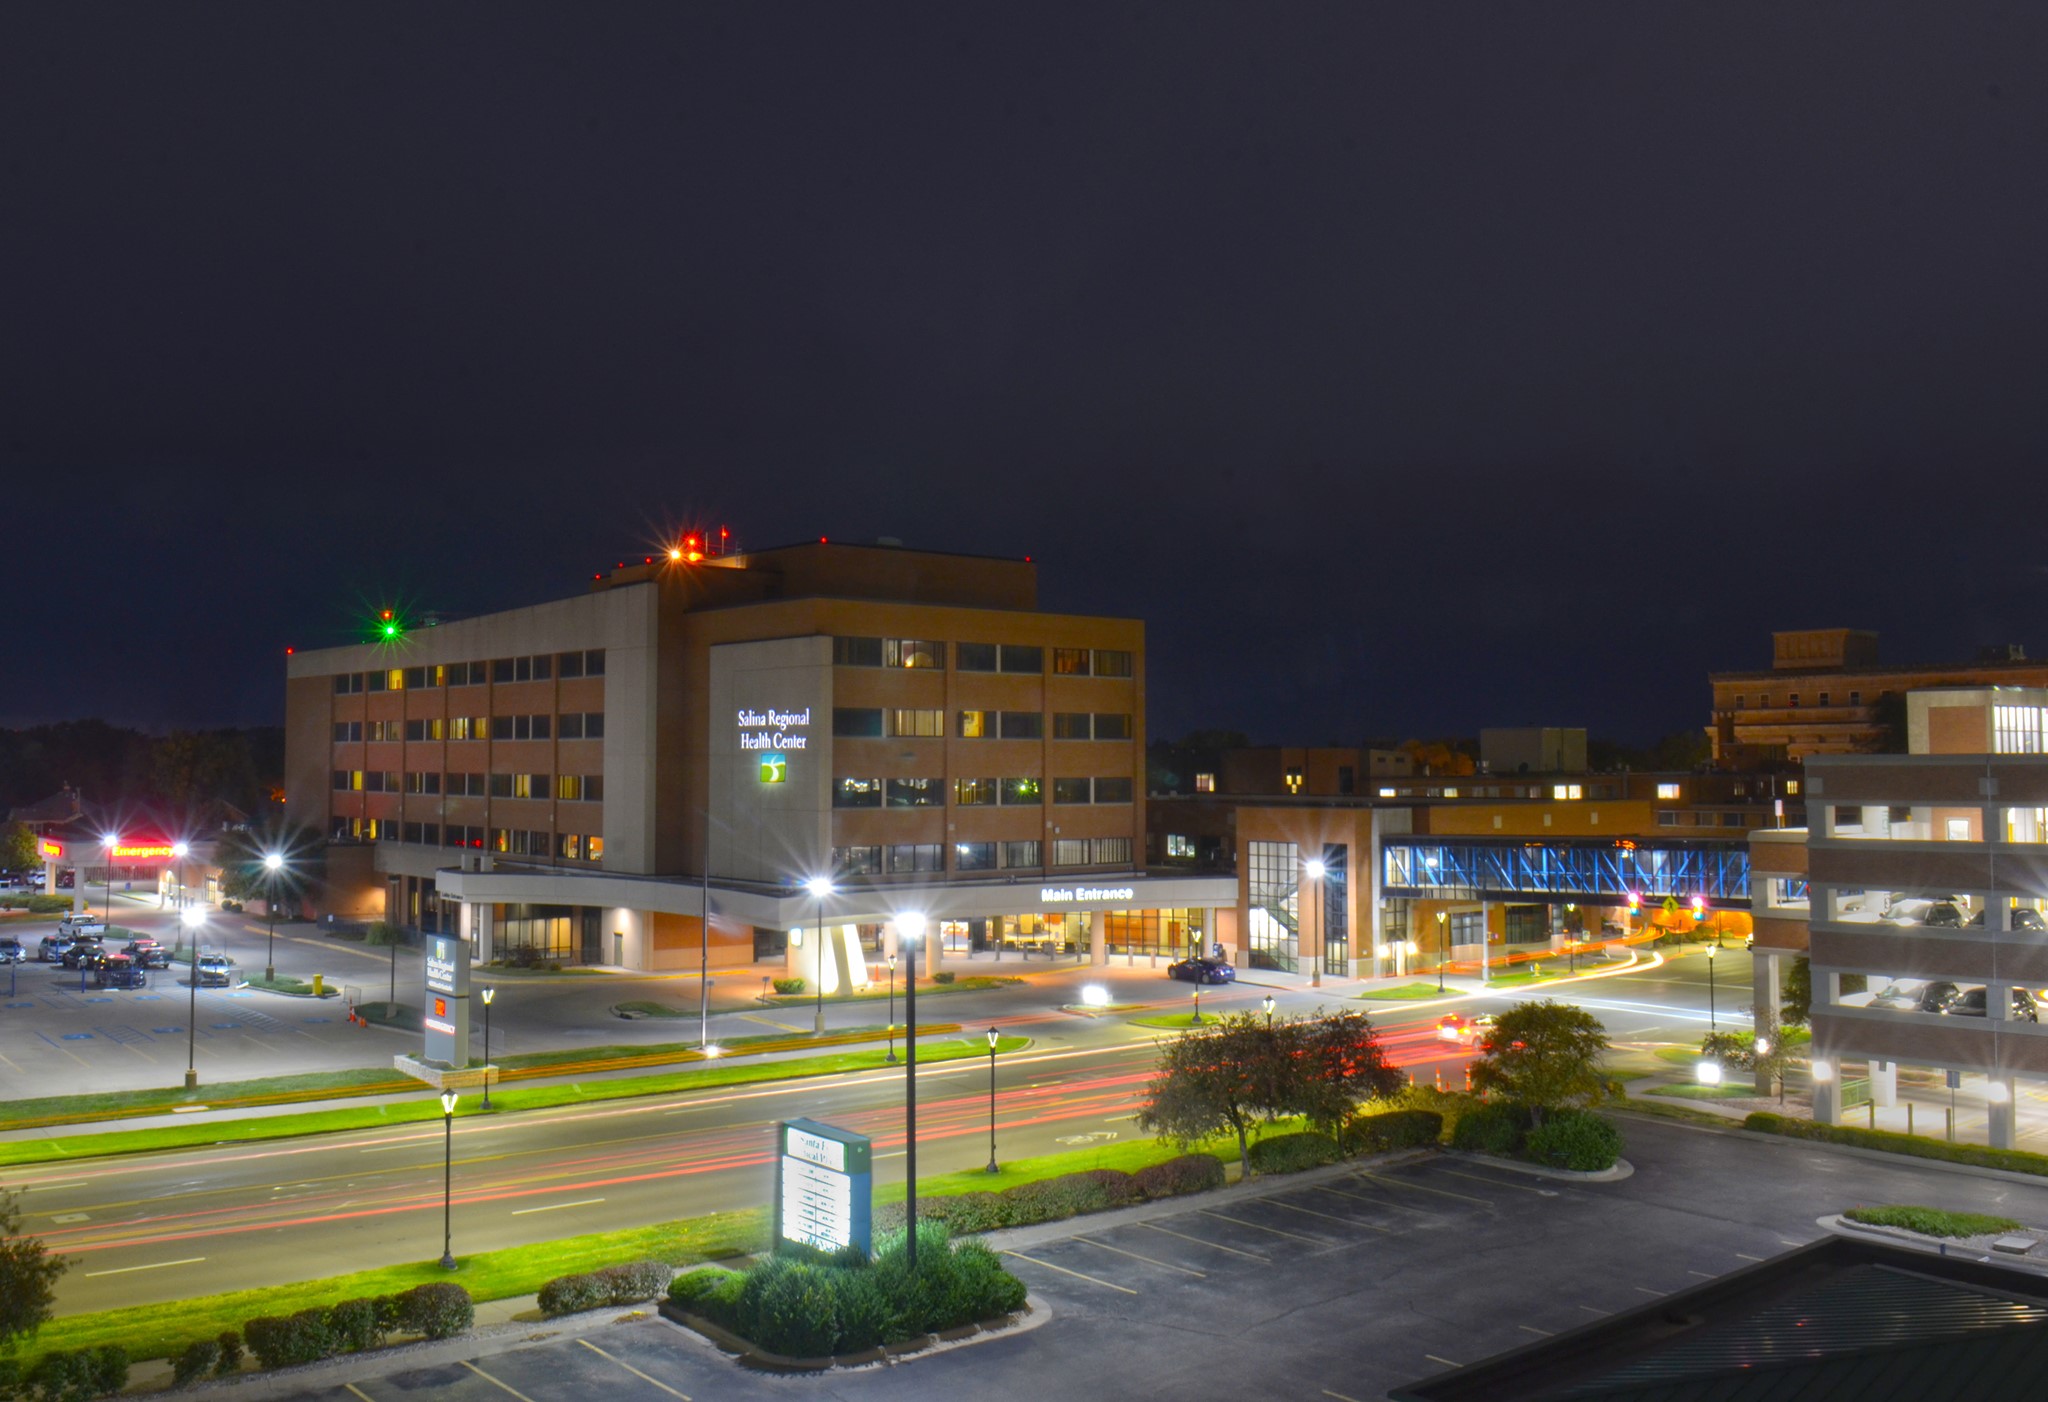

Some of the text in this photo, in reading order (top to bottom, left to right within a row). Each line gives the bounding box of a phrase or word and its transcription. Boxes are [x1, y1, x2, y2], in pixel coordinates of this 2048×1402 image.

[738, 707, 810, 731] Salina Regional
[741, 732, 807, 749] Health Center
[112, 845, 175, 858] Emergency
[1041, 887, 1133, 902] Main Entrance
